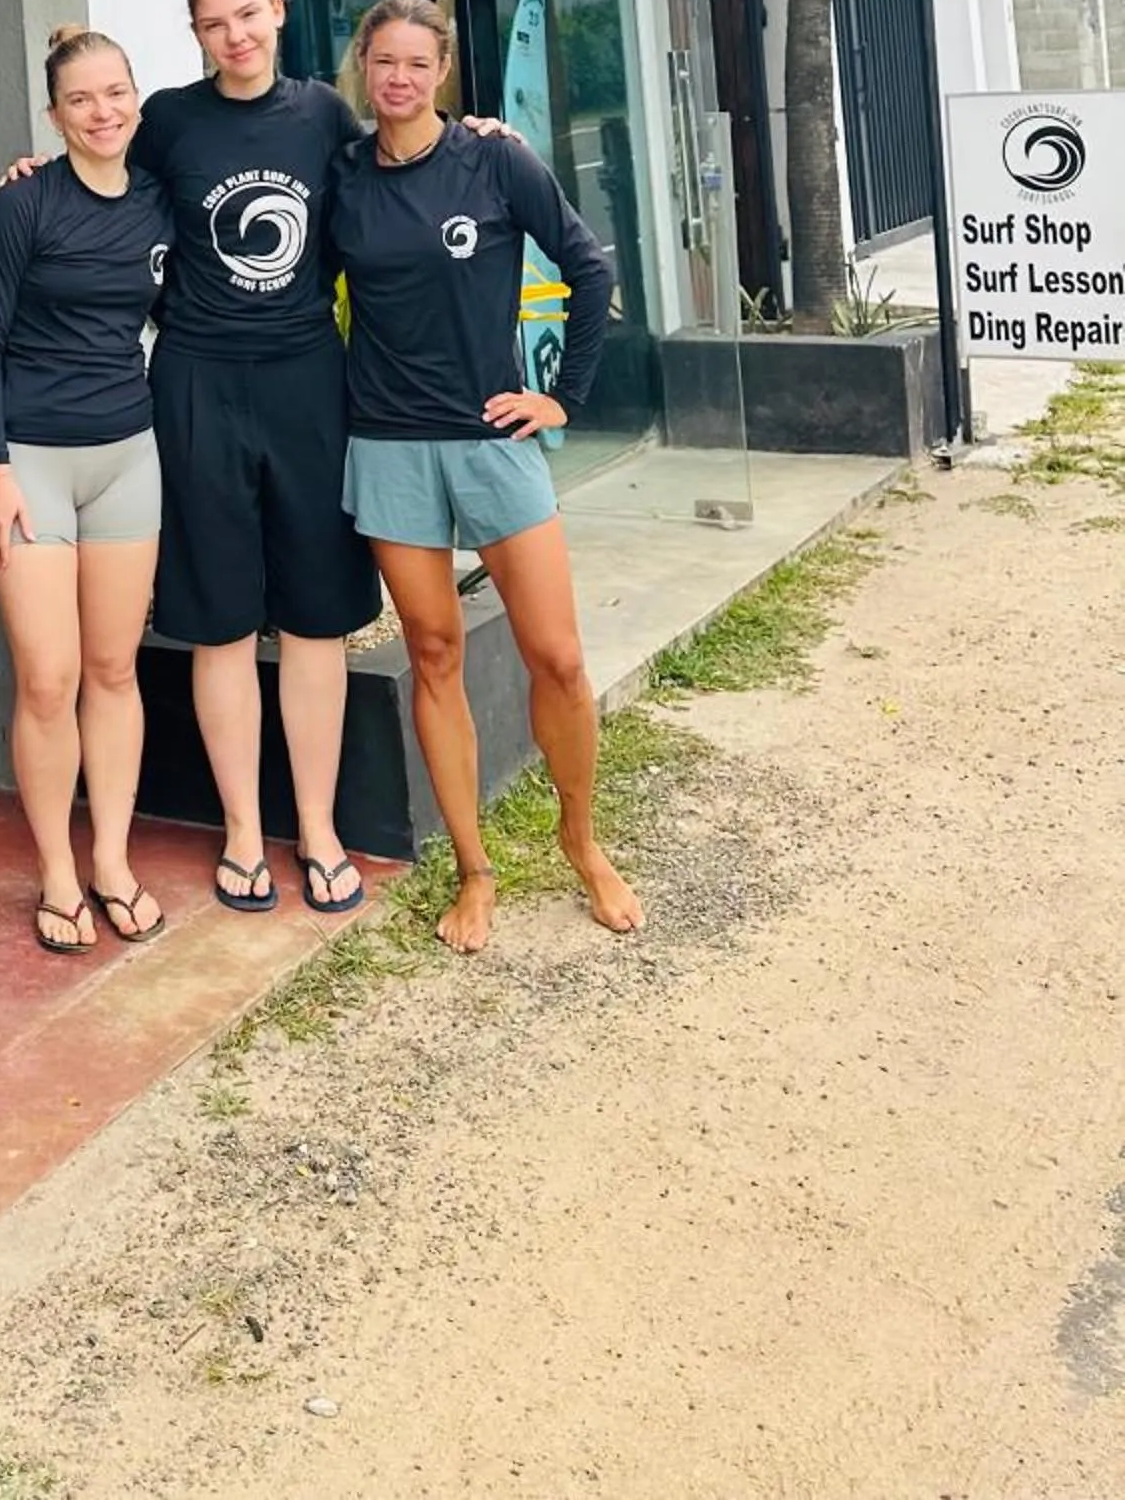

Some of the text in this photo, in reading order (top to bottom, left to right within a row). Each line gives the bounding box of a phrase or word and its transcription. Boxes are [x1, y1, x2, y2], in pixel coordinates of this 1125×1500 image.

[202, 184, 227, 210] COCO
[224, 170, 260, 189] PLANT
[262, 169, 292, 185] SURF
[962, 213, 1092, 252] Surf Shop
[965, 262, 1125, 295] Surf Lesson
[968, 311, 1124, 352] Ding Repair
